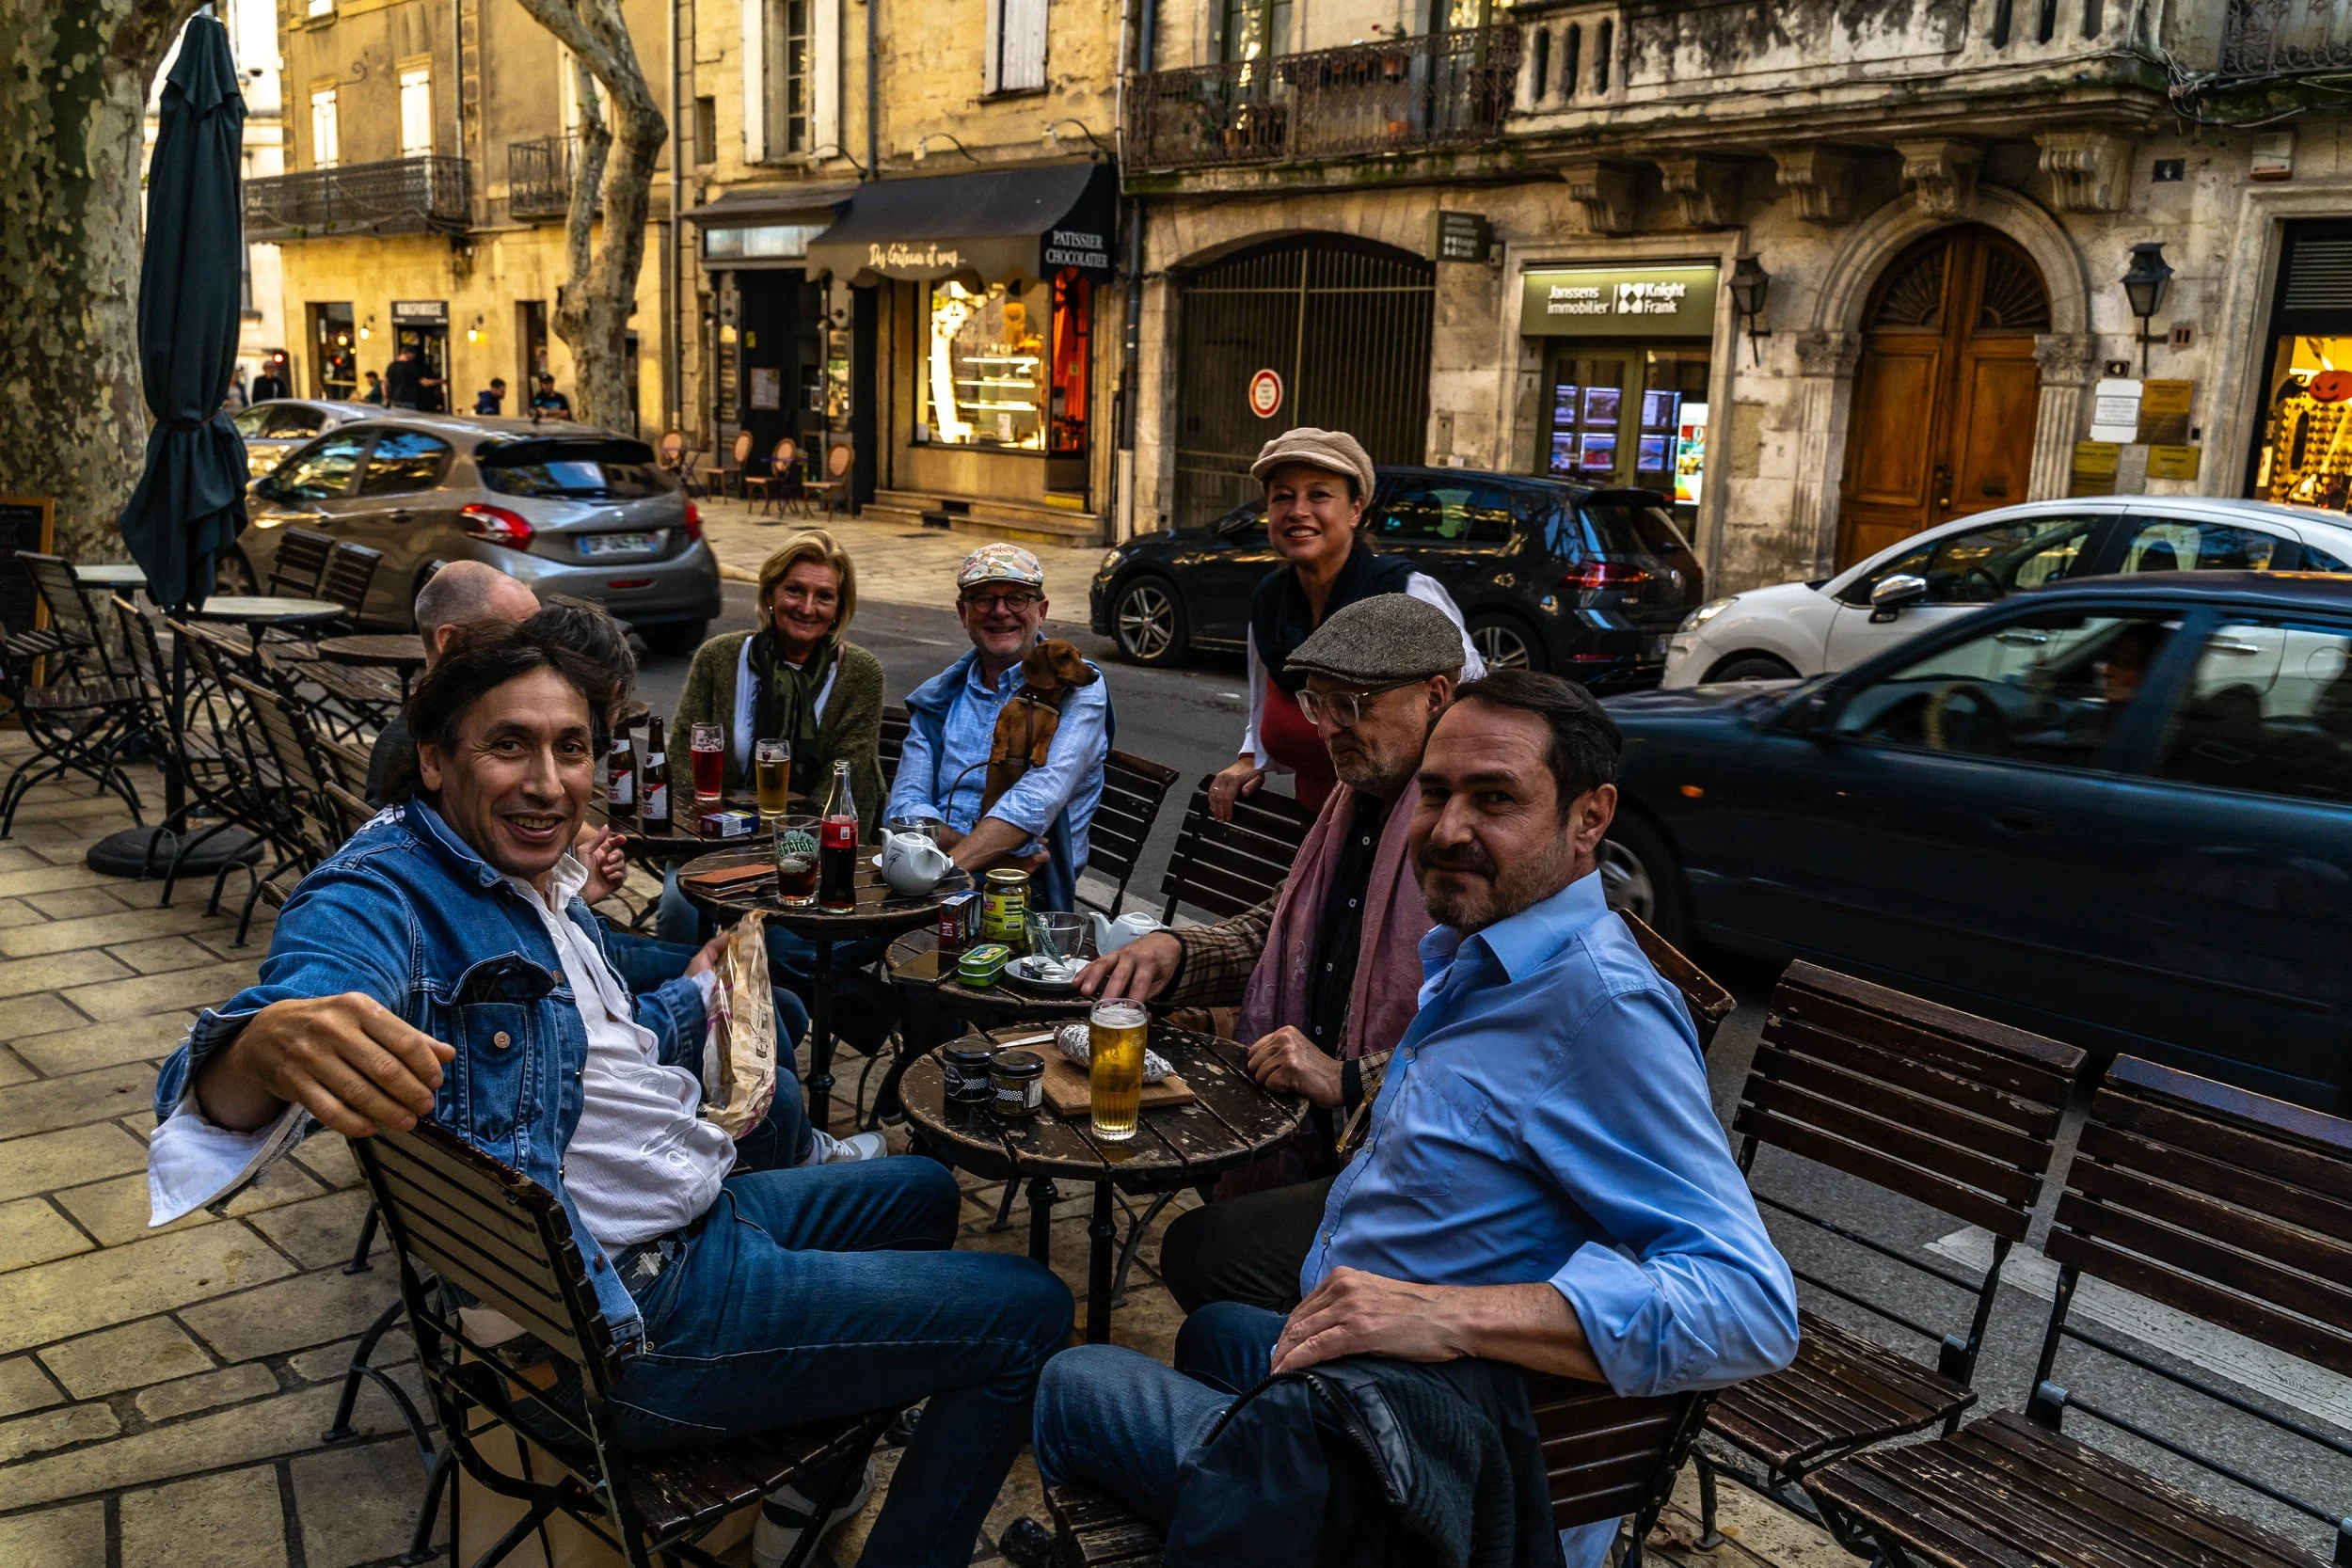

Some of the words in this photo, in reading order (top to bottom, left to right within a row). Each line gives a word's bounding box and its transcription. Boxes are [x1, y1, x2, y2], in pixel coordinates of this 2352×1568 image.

[1053, 230, 1104, 250] PATISSIER
[1045, 247, 1109, 269] CHOCOLATIER
[1548, 285, 1600, 300] Janssens
[1645, 282, 1687, 300] Knight
[1548, 300, 1610, 315] immobilier
[1645, 300, 1677, 314] Frank
